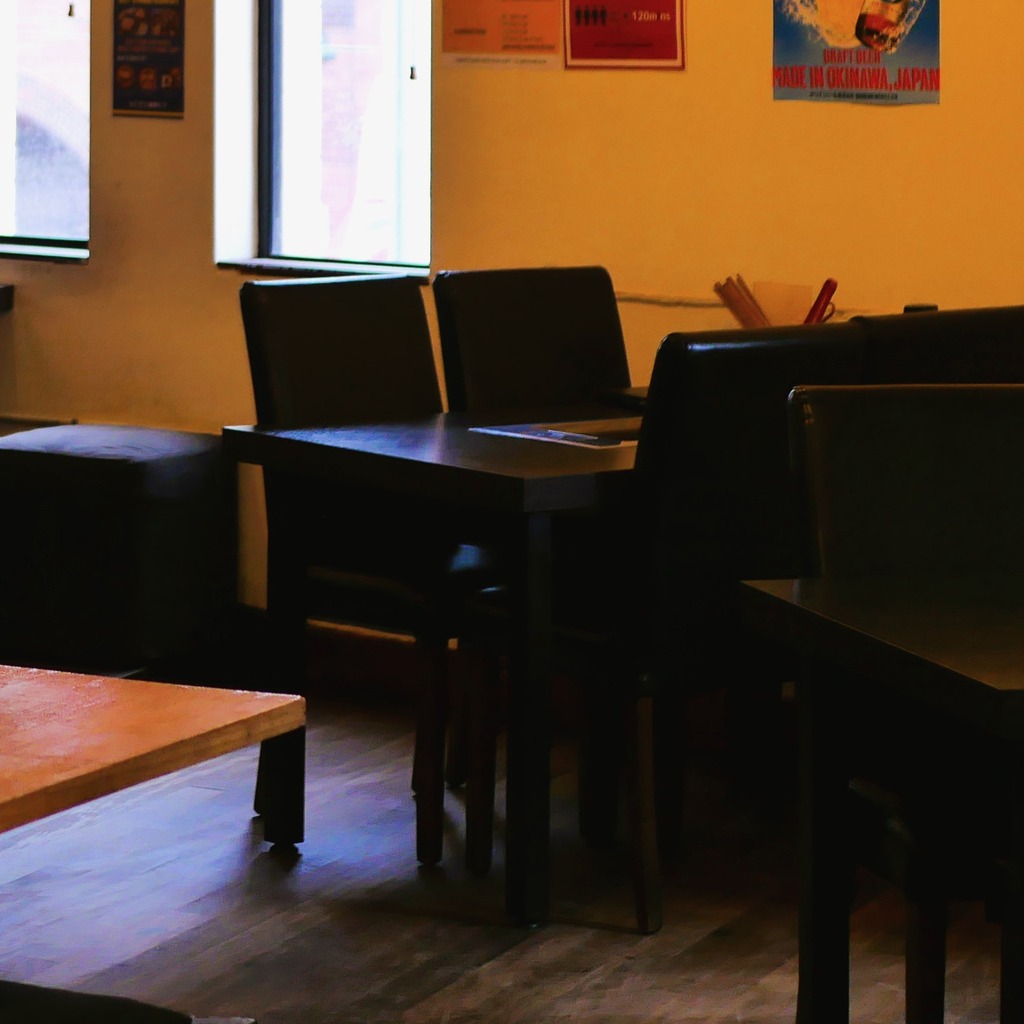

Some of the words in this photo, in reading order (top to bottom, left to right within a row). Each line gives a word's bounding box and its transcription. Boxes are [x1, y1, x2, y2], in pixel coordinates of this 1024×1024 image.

[773, 65, 807, 88] MADE
[810, 66, 824, 88] IN
[895, 67, 940, 91] JAPAN
